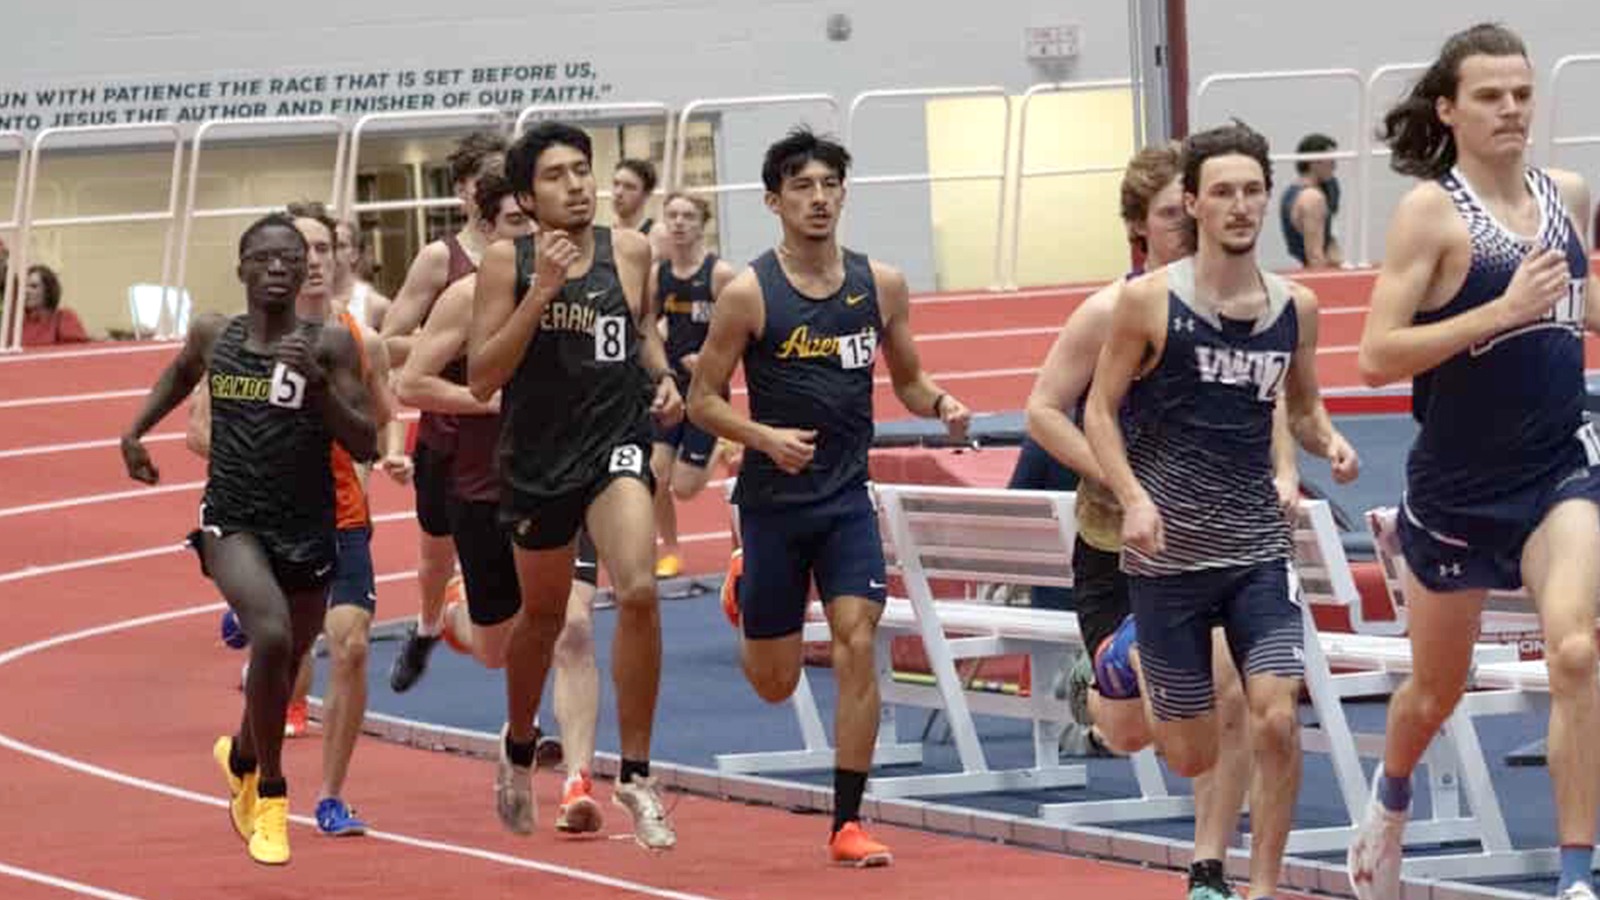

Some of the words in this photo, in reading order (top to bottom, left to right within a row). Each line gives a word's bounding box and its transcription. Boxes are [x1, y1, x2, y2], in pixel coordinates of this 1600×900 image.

[36, 88, 96, 107] WITH
[103, 81, 211, 103] PATIENCE
[218, 78, 264, 97] THE
[269, 75, 327, 94] RACE
[334, 73, 390, 90] THAT
[397, 70, 416, 88] IS
[424, 69, 463, 86] SET
[472, 63, 557, 83] BEFORE
[565, 61, 596, 80] US,
[52, 109, 117, 127] JESUS
[124, 107, 168, 123] THE
[177, 102, 267, 122] AUTHOR
[276, 100, 323, 117] AND
[331, 93, 435, 114] FINISHER
[442, 92, 470, 109] OF
[478, 88, 524, 106] OUR
[603, 320, 620, 358] 8
[847, 336, 872, 364] 15
[277, 366, 297, 403] 5
[616, 447, 636, 467] 8
